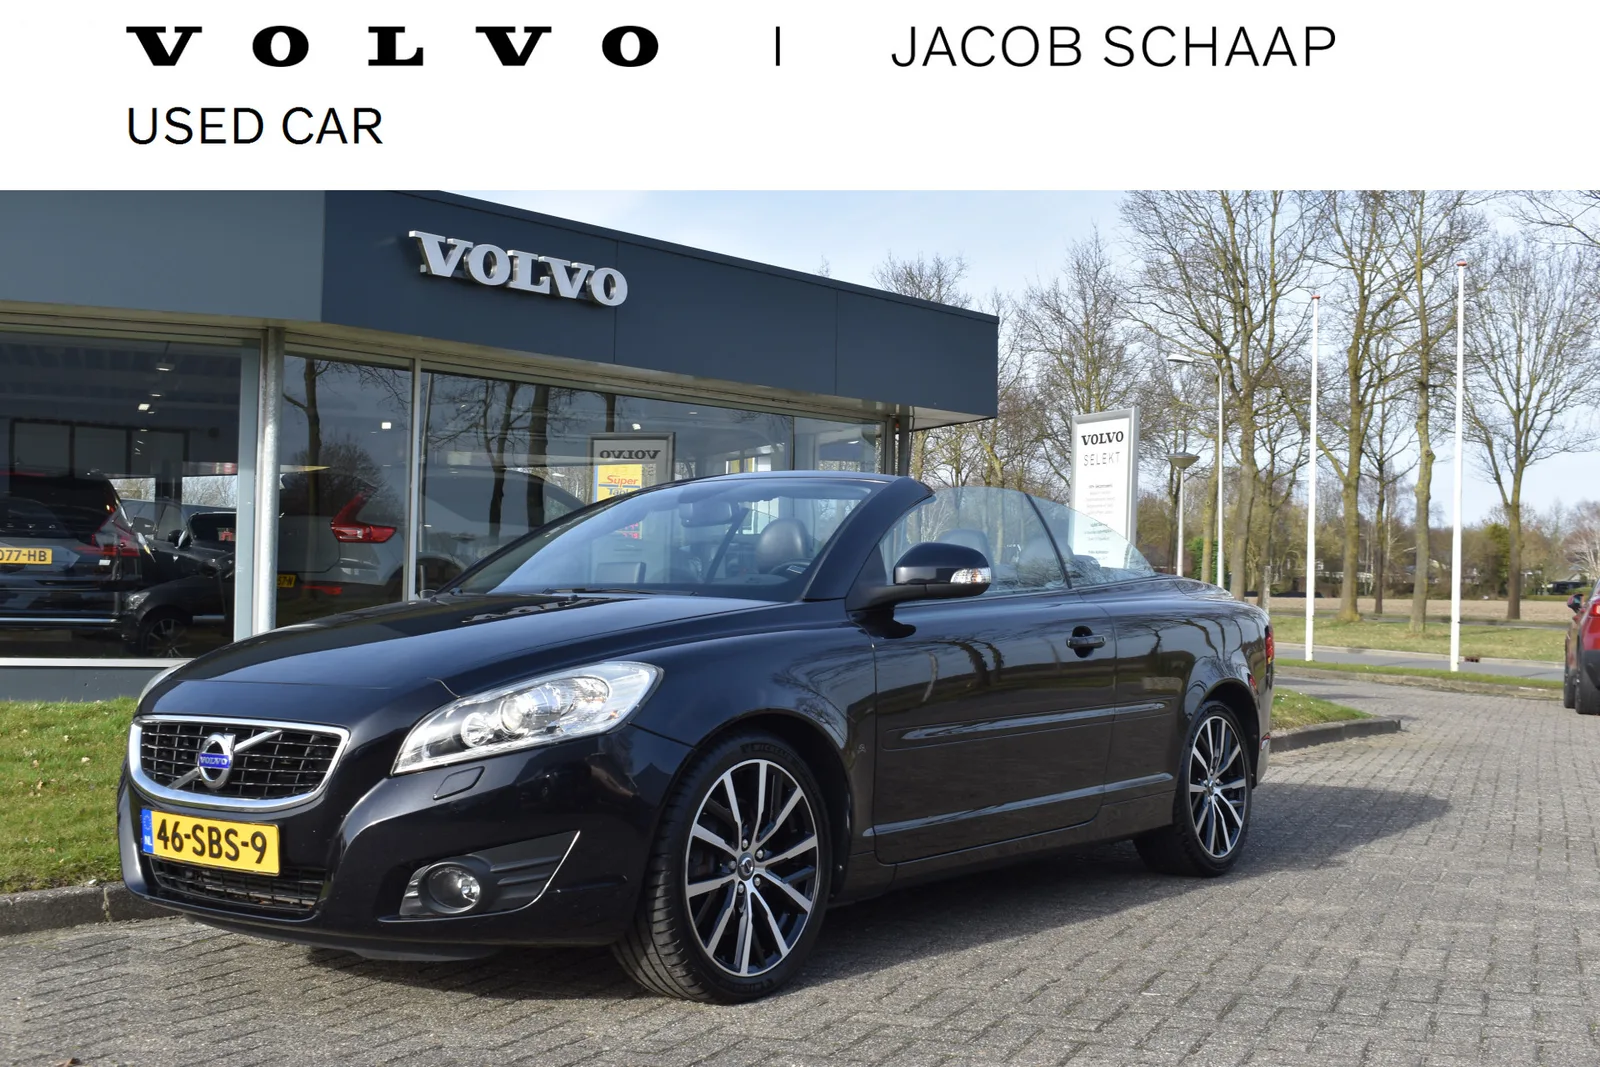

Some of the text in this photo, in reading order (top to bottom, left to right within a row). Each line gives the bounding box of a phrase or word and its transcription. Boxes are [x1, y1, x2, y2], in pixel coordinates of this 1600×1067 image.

[409, 230, 628, 307] VOLVO
[1081, 431, 1124, 446] VOLVO
[1083, 451, 1120, 466] SELEKT
[607, 475, 638, 487] Super
[200, 755, 228, 766] VOLVO
[144, 835, 153, 846] NL
[157, 818, 267, 865] 46-SBS-9
